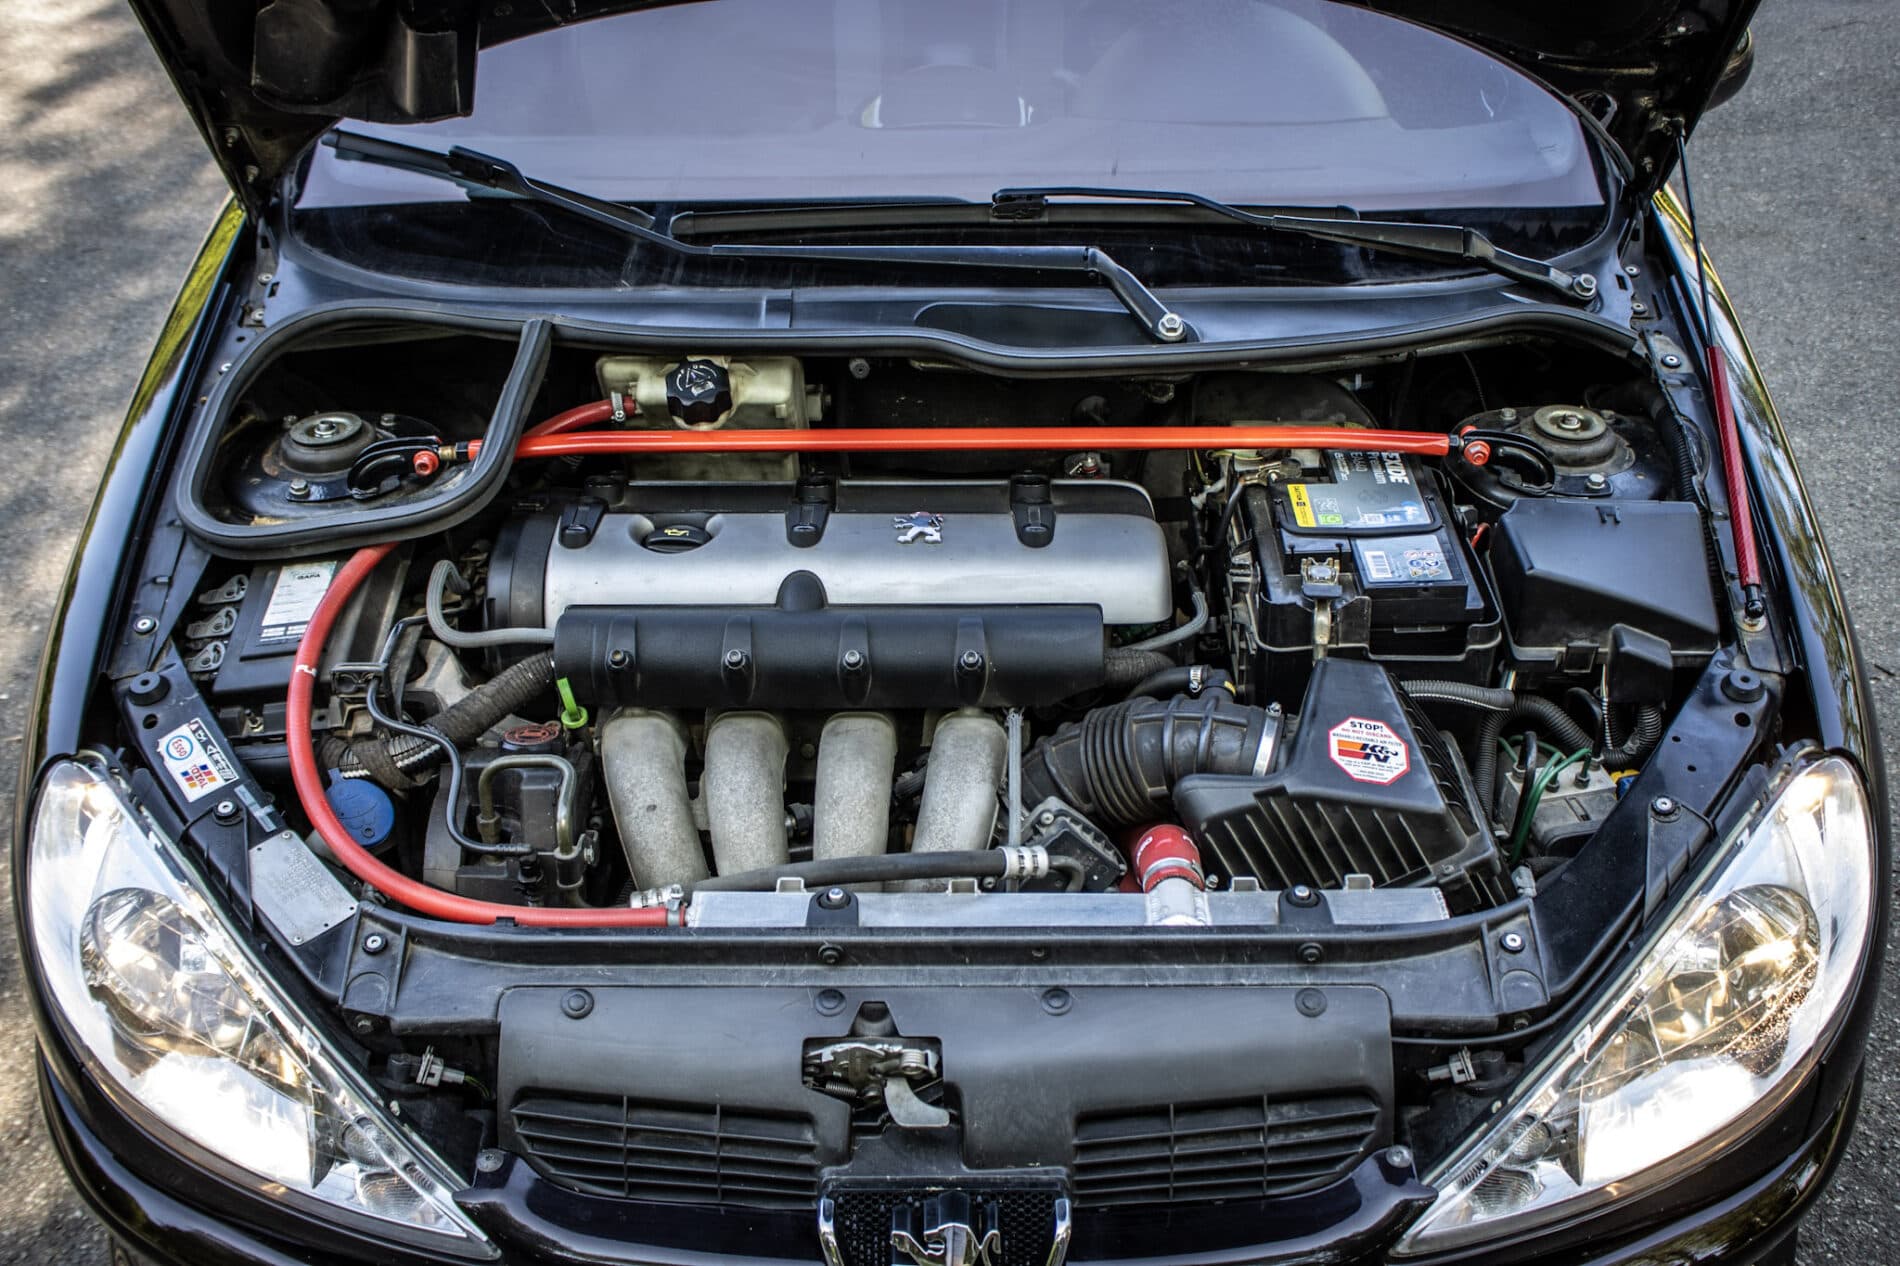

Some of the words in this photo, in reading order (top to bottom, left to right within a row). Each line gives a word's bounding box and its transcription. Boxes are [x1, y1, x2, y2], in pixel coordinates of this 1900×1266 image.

[1367, 451, 1387, 485] Premium
[1380, 451, 1410, 485] EXIDE
[1350, 721, 1383, 732] STOP!
[191, 764, 209, 788] TOTAL
